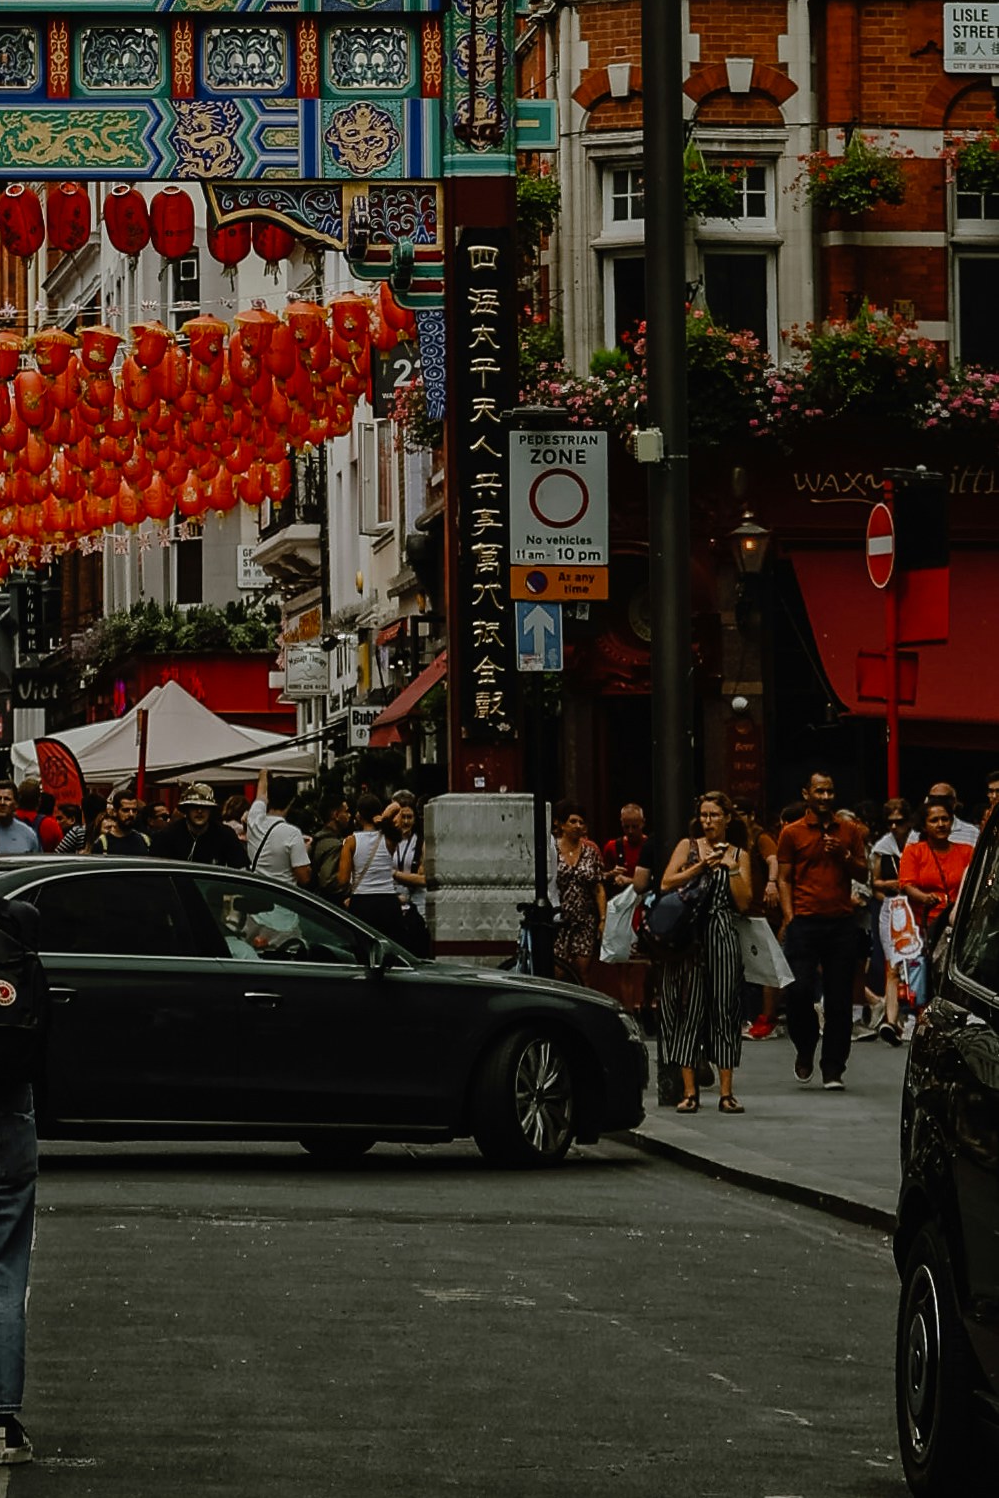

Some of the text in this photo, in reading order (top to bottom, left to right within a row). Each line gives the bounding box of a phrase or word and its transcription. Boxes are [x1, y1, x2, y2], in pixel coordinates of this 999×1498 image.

[952, 8, 989, 22] LISLE
[519, 435, 598, 445] PEDESTRIAN
[530, 449, 587, 465] ZONE
[526, 535, 592, 545] No vehicles
[516, 550, 525, 559] 11
[528, 552, 545, 560] am
[557, 548, 574, 561] 10
[578, 551, 601, 563] pm
[575, 575, 595, 585] any
[564, 585, 589, 595] time
